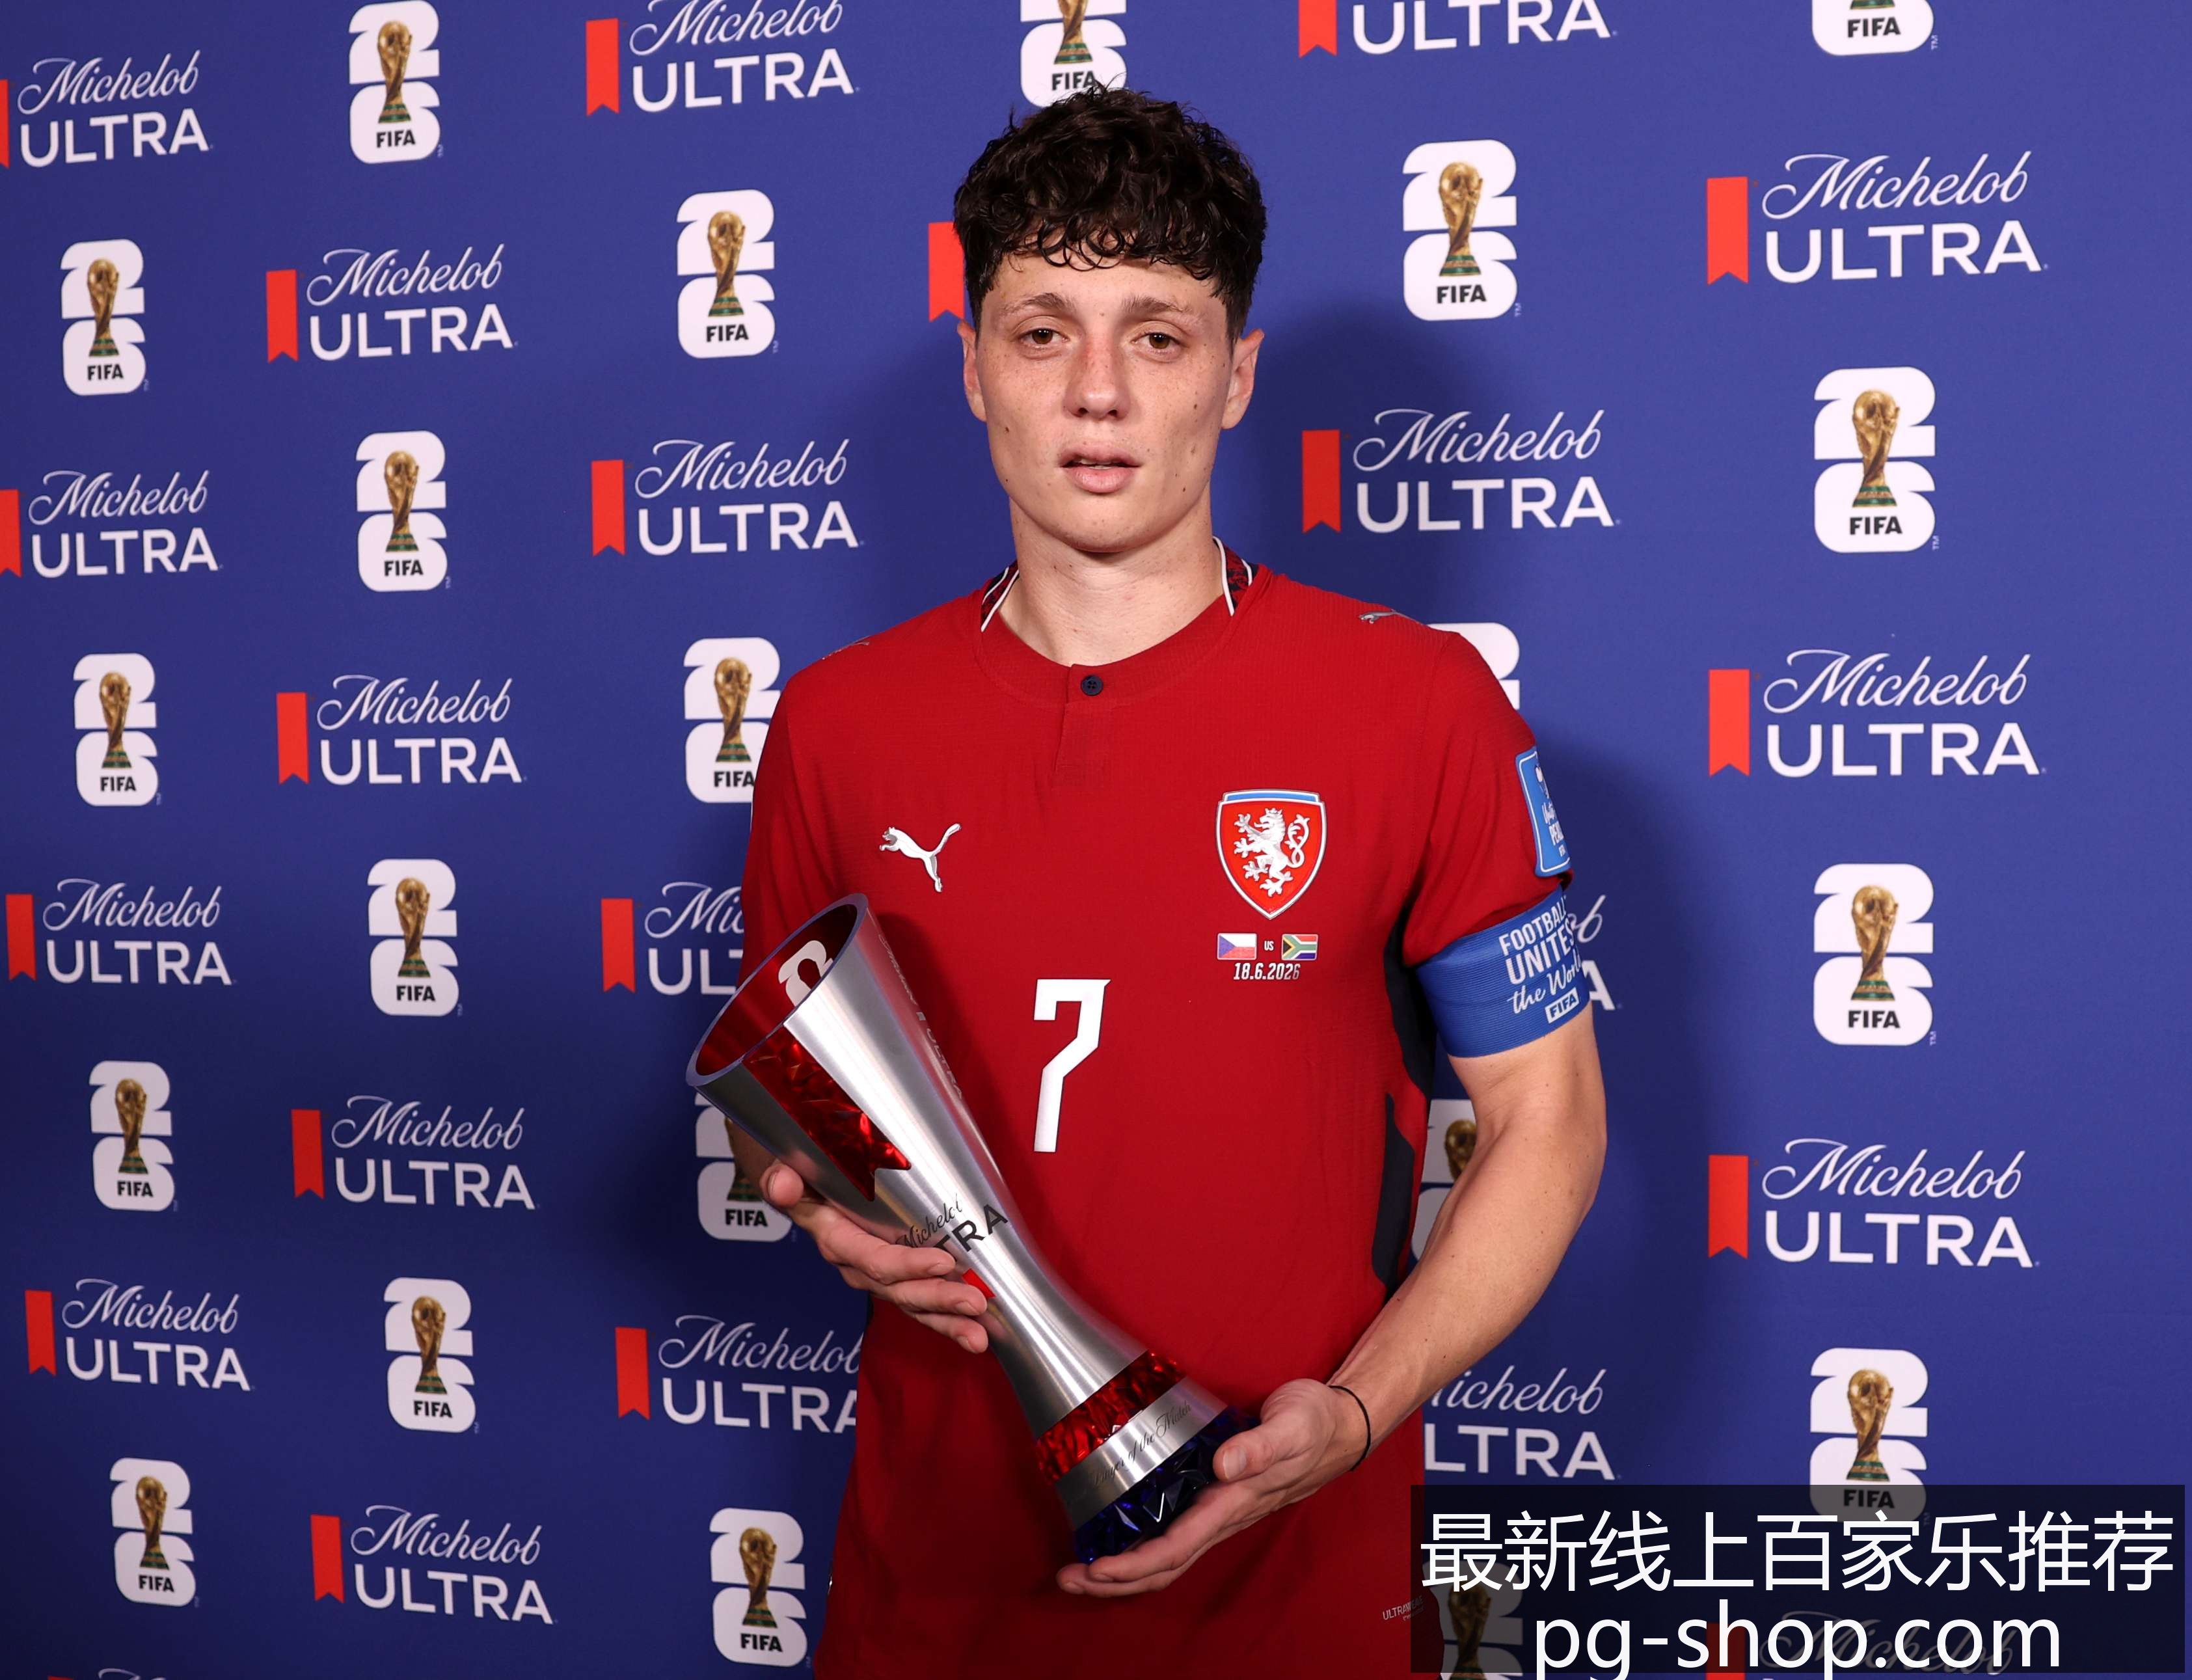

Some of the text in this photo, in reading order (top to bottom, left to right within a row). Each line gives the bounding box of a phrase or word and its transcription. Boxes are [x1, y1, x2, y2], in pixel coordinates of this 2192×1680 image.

[630, 0, 843, 55] Michelob
[1353, 0, 1610, 54] ULTRA
[1848, 18, 1900, 37] FIFA
[18, 50, 200, 116] Michelob
[632, 48, 854, 112] ULTRA
[1051, 71, 1096, 91] FIFA
[20, 108, 209, 167] ULTRA
[377, 130, 415, 148] FIFA
[1763, 151, 2031, 219] Michelob
[307, 244, 504, 306] Michelob
[1766, 221, 2041, 283] ULTRA
[1437, 285, 1486, 303] FIFA
[310, 304, 513, 360] ULTRA
[707, 325, 748, 342] FIFA
[88, 364, 123, 380] FIFA
[1353, 409, 1604, 471] Michelob
[635, 439, 848, 498] Michelob
[29, 470, 208, 524] Michelob
[1358, 476, 1614, 532] ULTRA
[639, 501, 858, 555] ULTRA
[1850, 517, 1902, 535] FIFA
[33, 528, 218, 578] ULTRA
[385, 560, 423, 576] FIFA
[318, 675, 511, 730] Michelob
[1764, 650, 2030, 713] Michelob
[321, 737, 522, 785] ULTRA
[1768, 723, 2039, 777] ULTRA
[101, 777, 136, 791] FIFA
[714, 771, 755, 787] FIFA
[43, 879, 221, 930] Michelob
[47, 940, 232, 985] ULTRA
[1234, 963, 1300, 980] 18.6.2026
[1506, 918, 1575, 984] UNITES
[397, 986, 435, 1001] FIFA
[1507, 985, 1547, 1014] the
[1550, 996, 1576, 1018] FIFA
[1848, 1010, 1900, 1028] FIFA
[1033, 979, 1111, 1153] 7
[332, 1096, 524, 1149] Michelob
[118, 1181, 153, 1197] FIFA
[336, 1158, 535, 1210] ULTRA
[1763, 1139, 2025, 1199] Michelob
[725, 1209, 767, 1226] FIFA
[934, 1204, 1008, 1262] TRA
[1766, 1211, 2033, 1267] ULTRA
[62, 1279, 239, 1333] Michelob
[66, 1337, 250, 1390] ULTRA
[1431, 1364, 1606, 1415] ichelob
[414, 1401, 452, 1418] FIFA
[1425, 1424, 1615, 1480] LTRA
[1844, 1489, 1894, 1508] FIFA
[351, 1505, 541, 1565] Michelob
[139, 1575, 174, 1592] FIFA
[355, 1564, 552, 1624] ULTRA
[741, 1634, 783, 1652] FIFA
